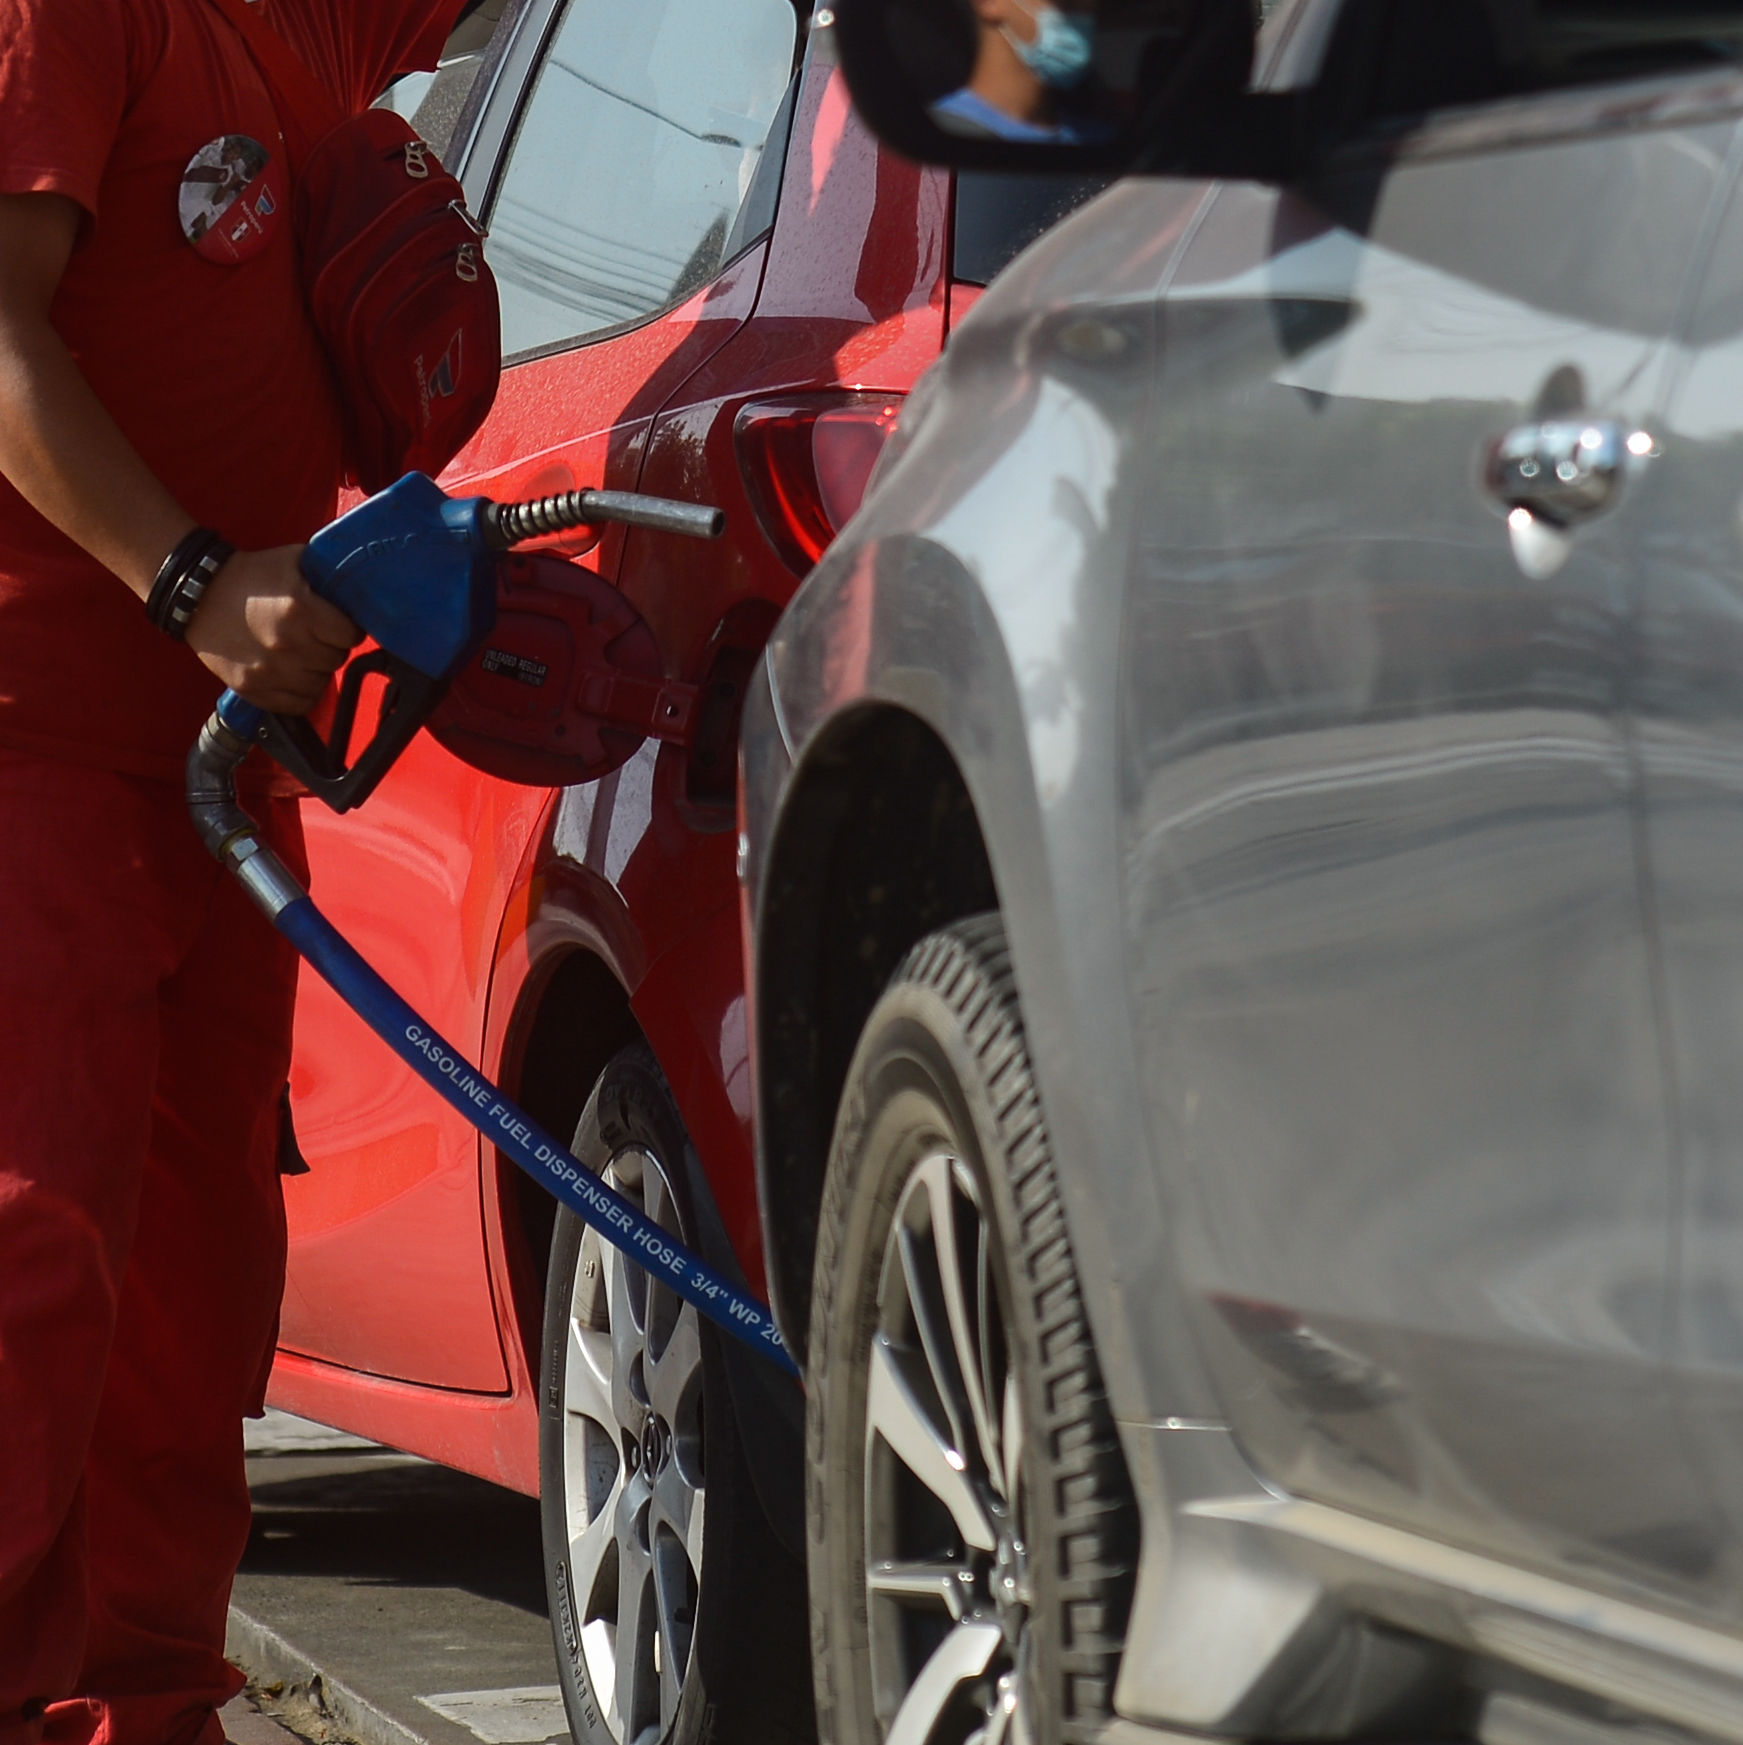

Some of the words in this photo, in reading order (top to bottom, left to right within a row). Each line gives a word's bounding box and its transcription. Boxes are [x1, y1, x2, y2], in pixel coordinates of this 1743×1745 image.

[404, 1024, 490, 1109] GASOLINE
[488, 1102, 532, 1150] FUEL
[534, 1145, 634, 1233] DISPENSER
[632, 1227, 688, 1275] HOSE
[728, 1297, 762, 1330] WP
